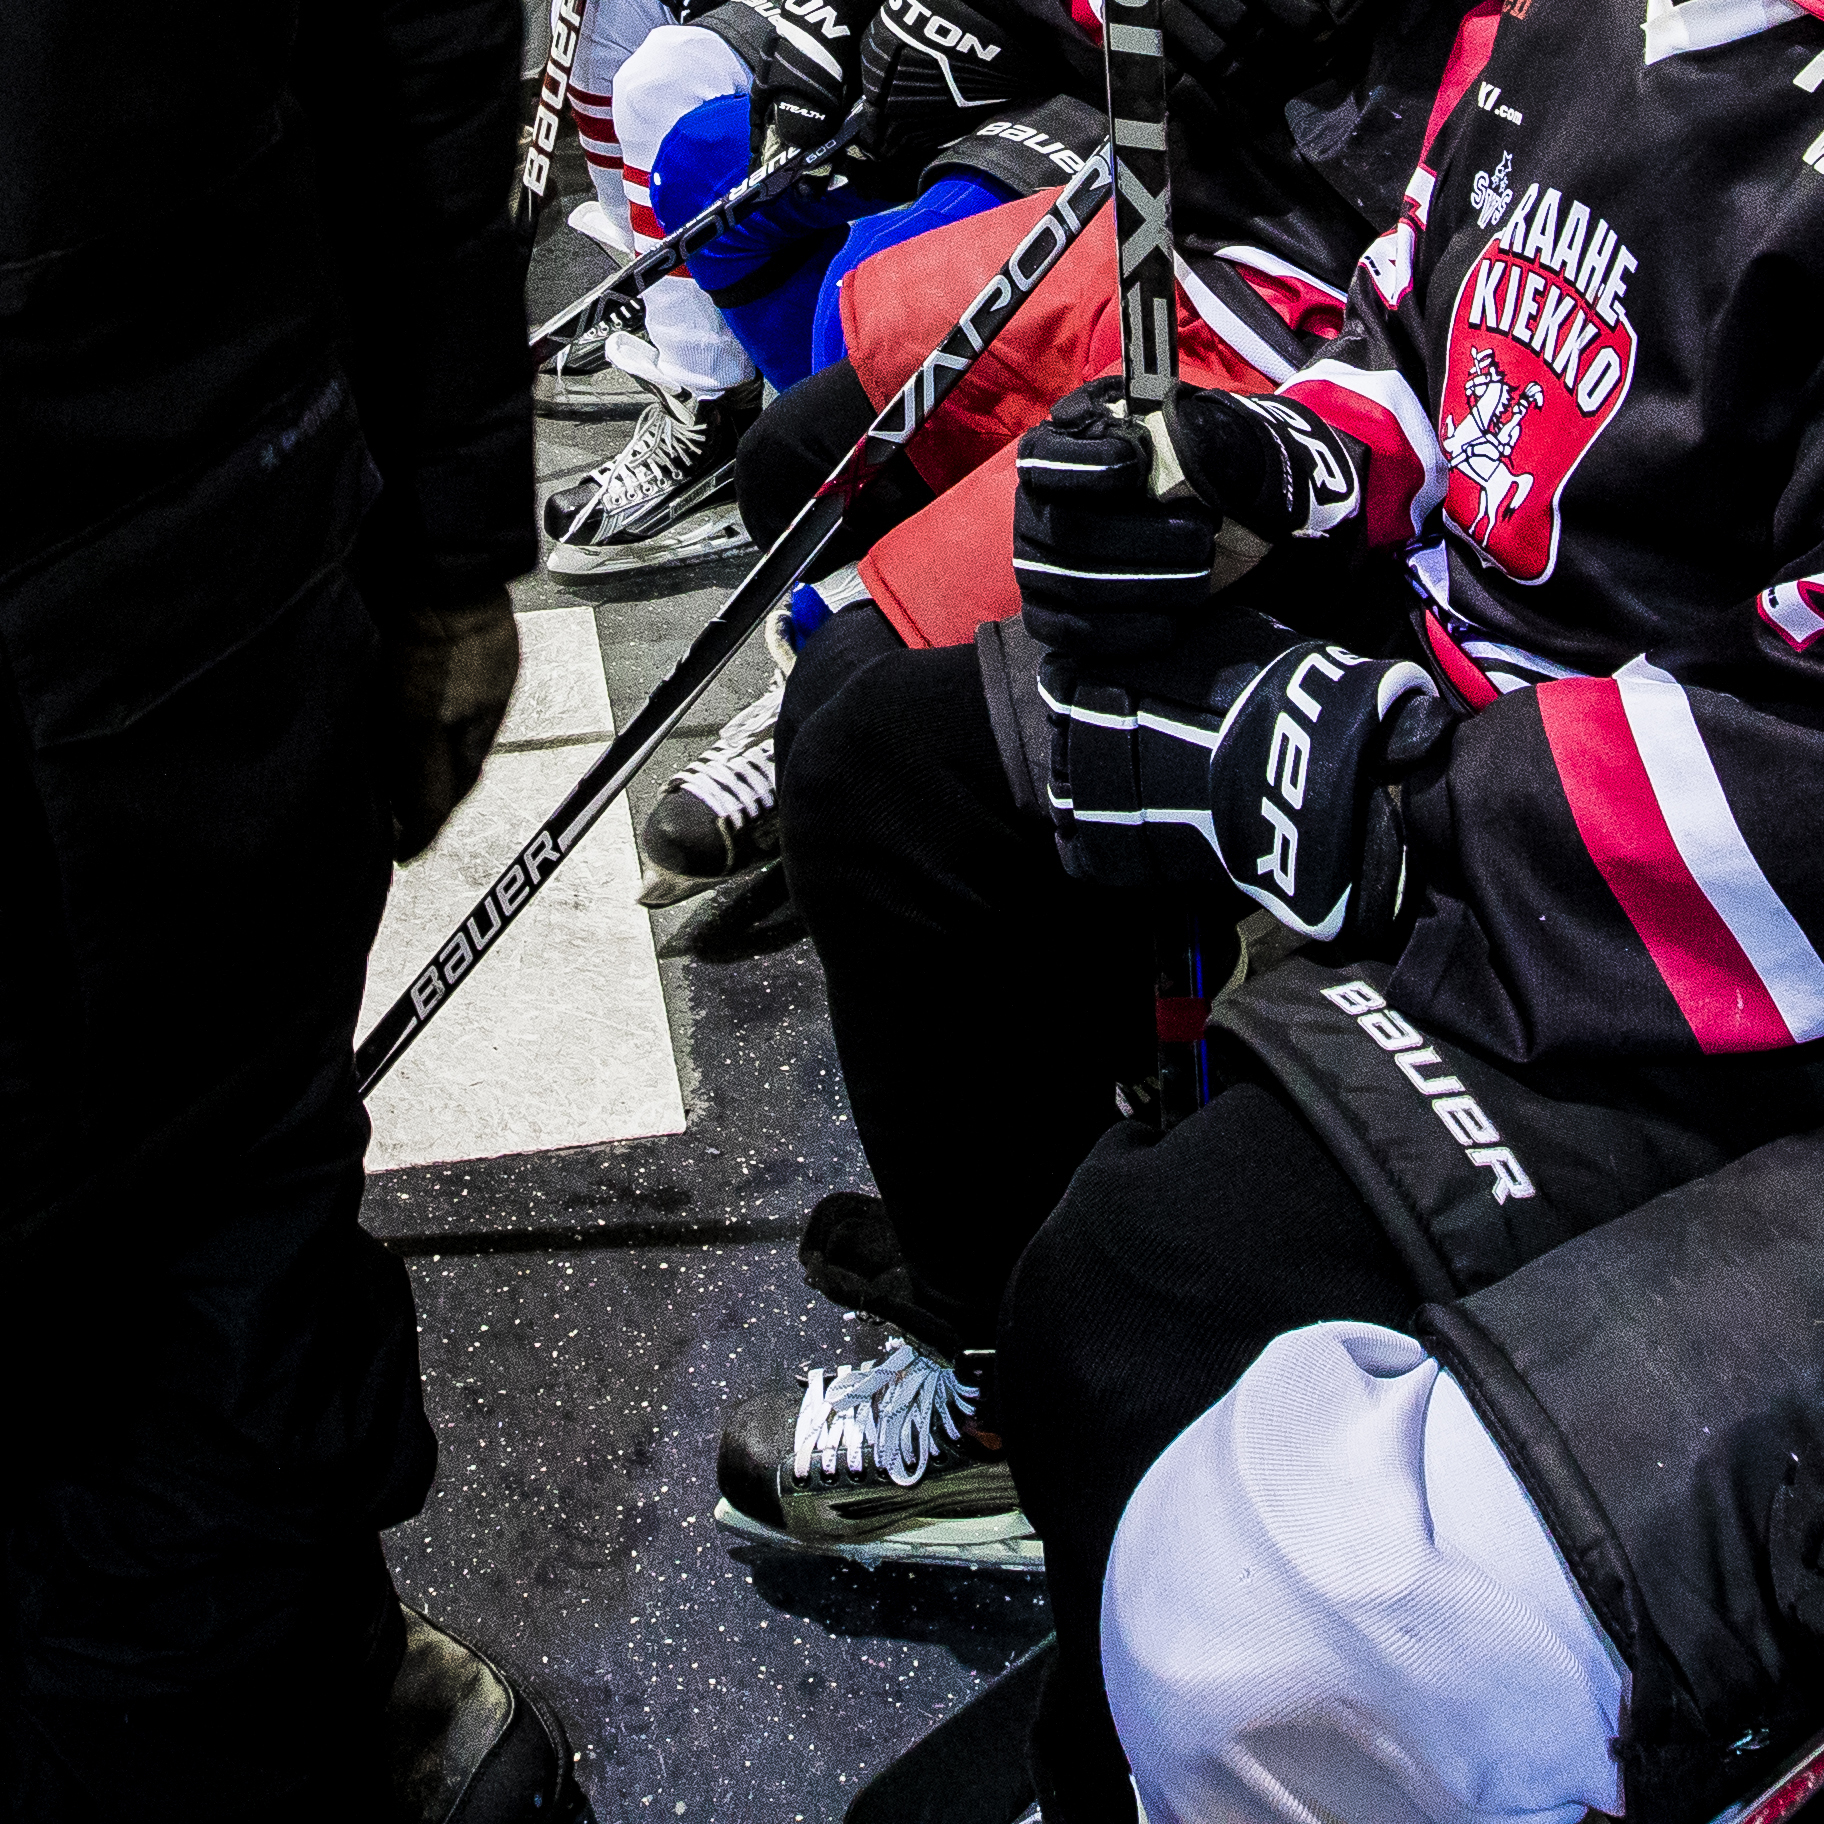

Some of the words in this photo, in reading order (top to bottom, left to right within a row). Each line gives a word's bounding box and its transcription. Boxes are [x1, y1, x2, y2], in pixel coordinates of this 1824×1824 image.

[778, 101, 826, 121] STEALTH
[977, 120, 1085, 175] BAUE
[869, 141, 1114, 444] VAPOR
[1468, 260, 1623, 416] KIEKKO
[1499, 182, 1639, 321] RAAHE
[1257, 644, 1373, 898] UER
[410, 829, 561, 1023] BAUER
[1318, 979, 1537, 1205] BAUER
